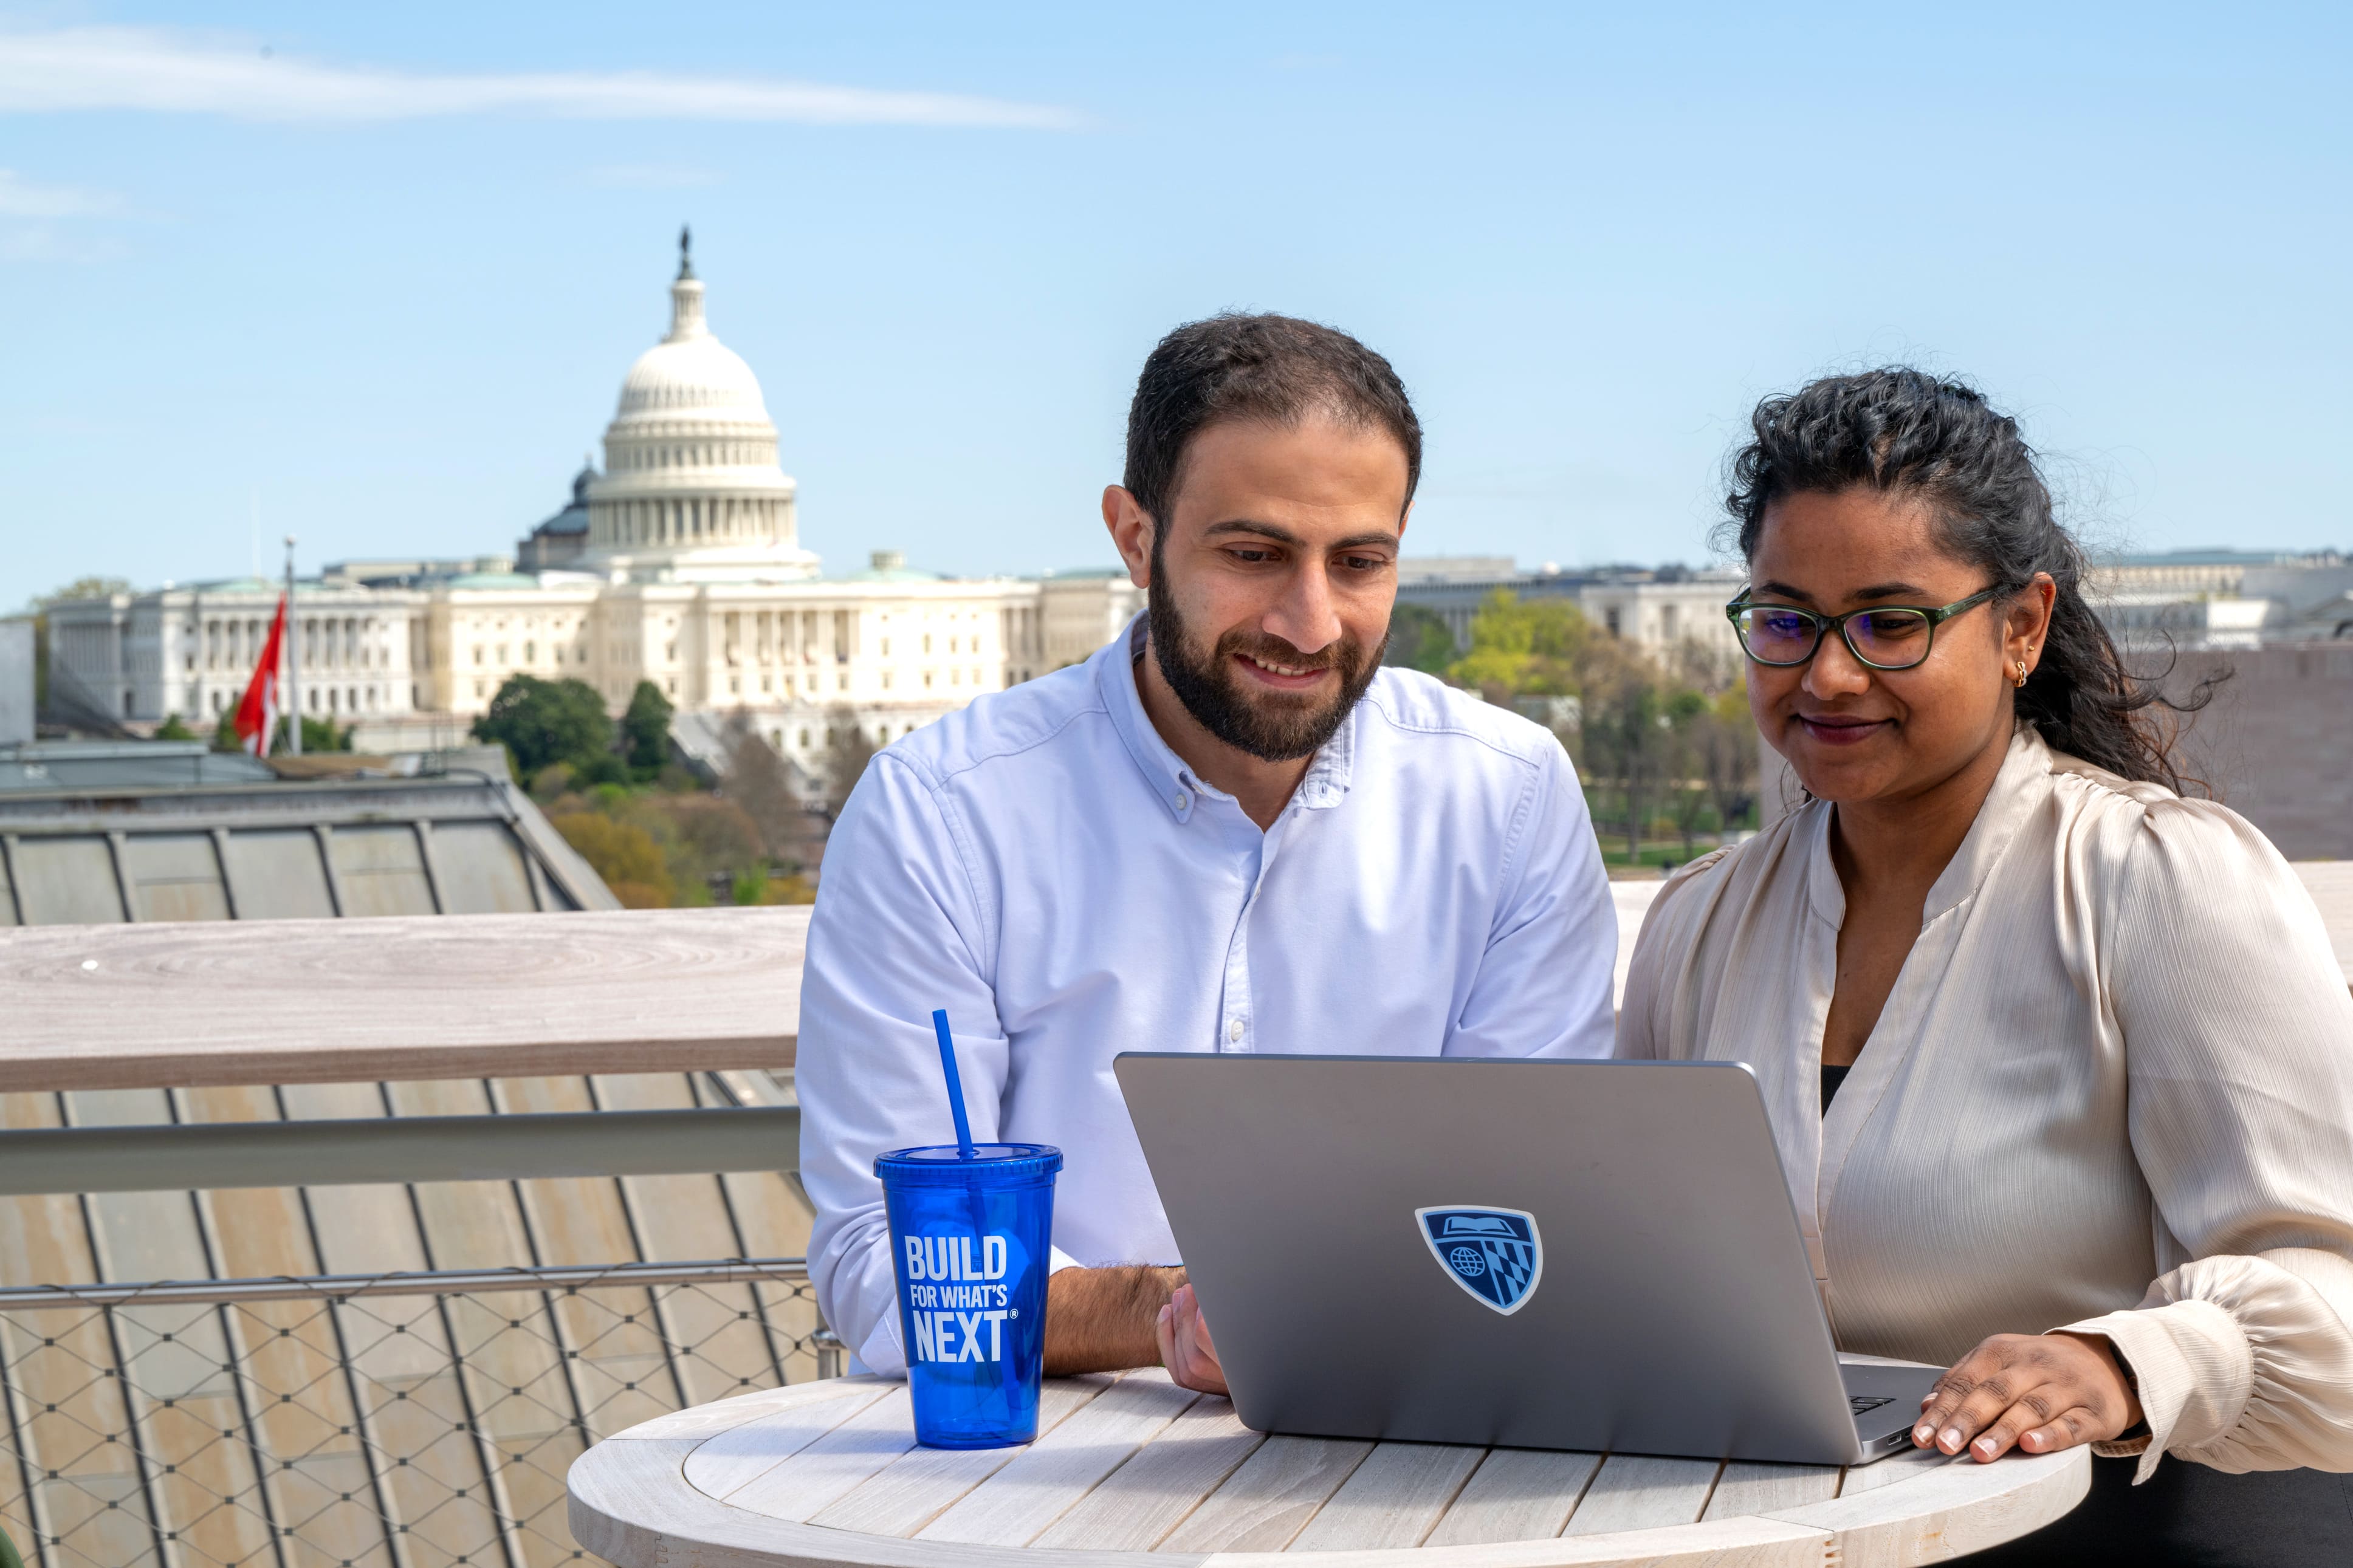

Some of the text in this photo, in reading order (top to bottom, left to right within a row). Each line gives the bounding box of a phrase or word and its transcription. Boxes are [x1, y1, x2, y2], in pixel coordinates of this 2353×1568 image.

[904, 1235, 1006, 1281] BUILD
[910, 1284, 1007, 1308] FOR WHAT'S
